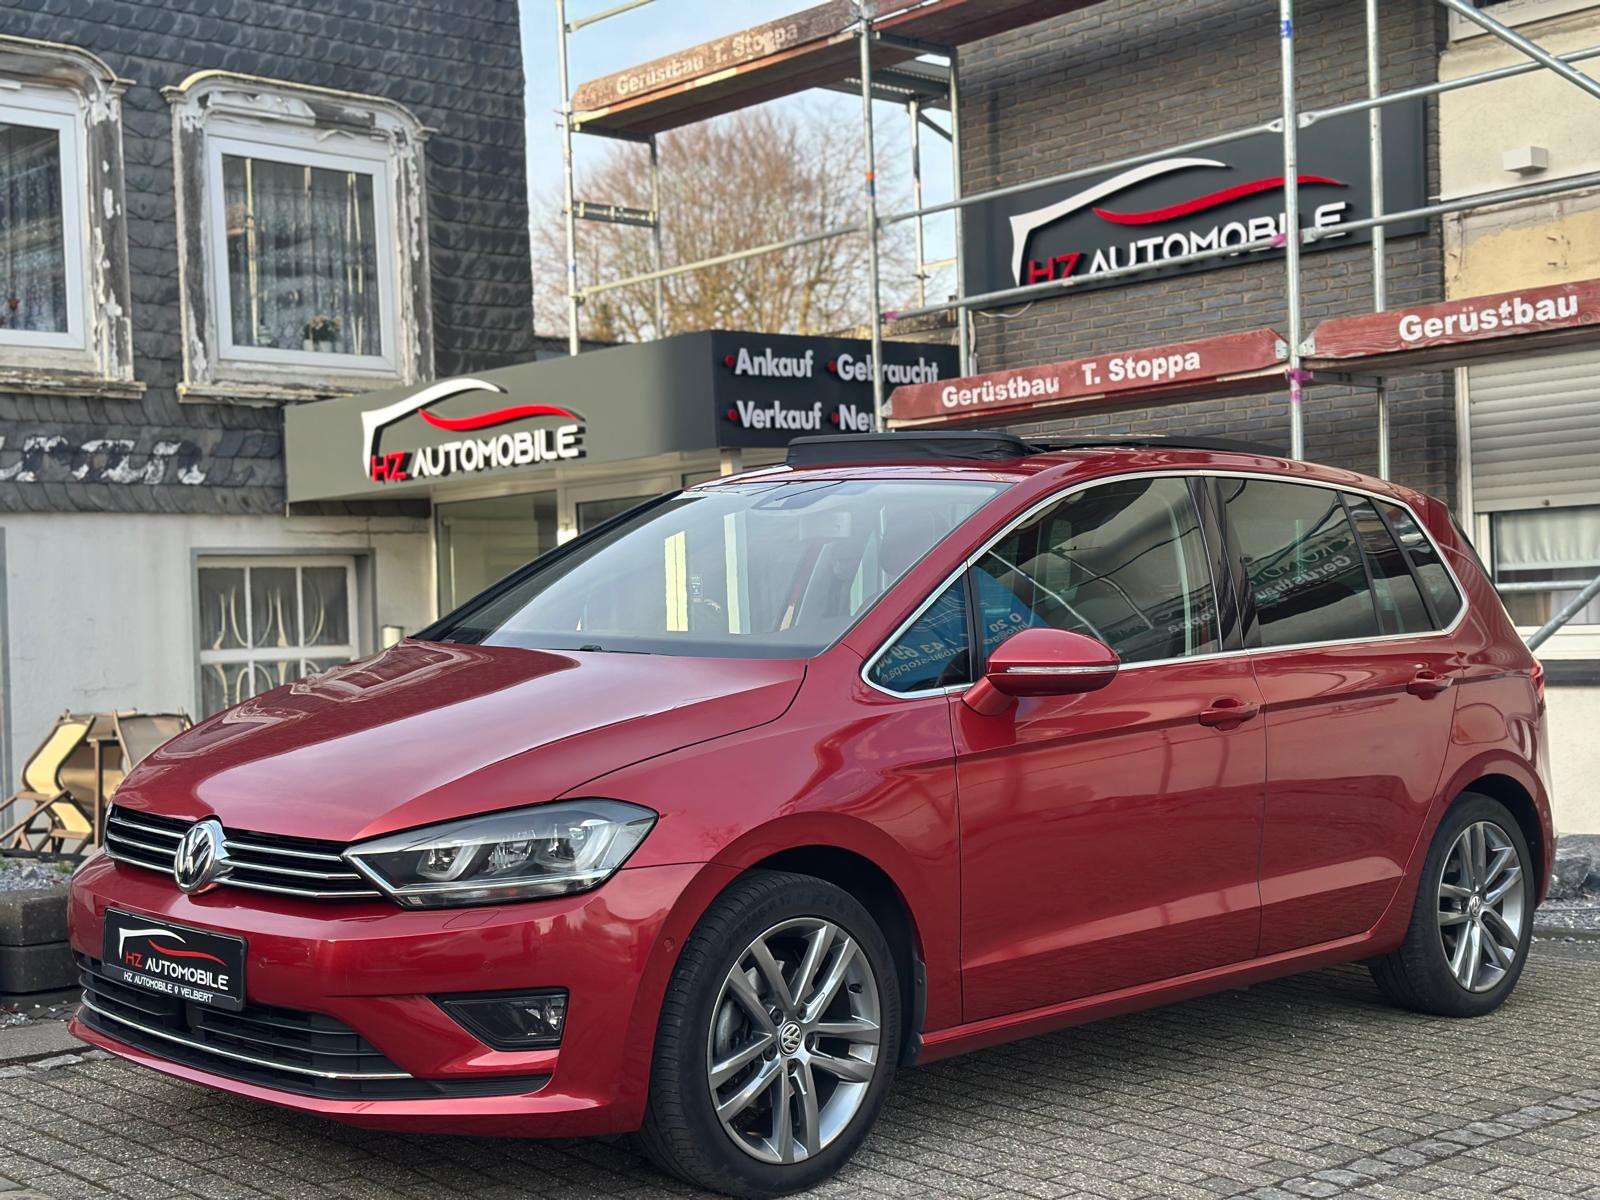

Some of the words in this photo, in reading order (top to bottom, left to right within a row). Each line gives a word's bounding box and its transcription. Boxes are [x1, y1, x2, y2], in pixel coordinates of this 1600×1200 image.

[1399, 295, 1579, 341] Gerüstbau
[735, 348, 814, 378] Ankauf
[942, 375, 1060, 408] Gerüstbau
[1082, 363, 1101, 386] T.
[1108, 351, 1201, 381] Stoppa
[736, 400, 822, 430] Verkauf
[371, 451, 407, 483] HZ
[412, 424, 580, 478] AUTOMOBILE
[123, 971, 133, 982] HZ
[134, 976, 173, 994] AUTOMOBILE
[180, 988, 214, 1004] VELBERT
[125, 952, 143, 968] HZ
[145, 957, 229, 991] AUTOMOBILE
